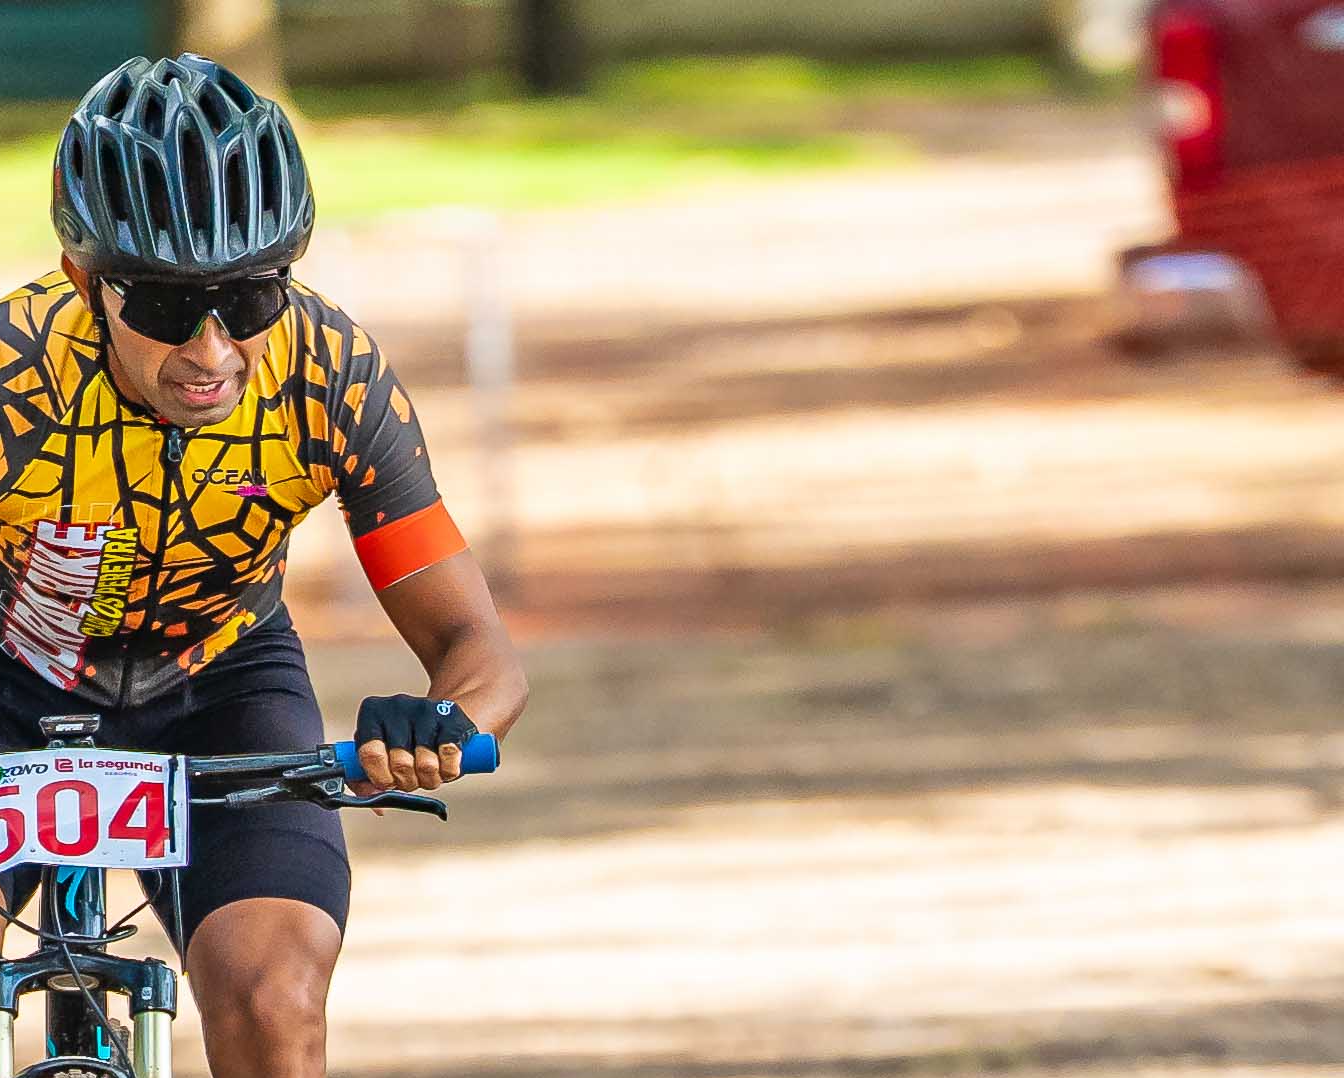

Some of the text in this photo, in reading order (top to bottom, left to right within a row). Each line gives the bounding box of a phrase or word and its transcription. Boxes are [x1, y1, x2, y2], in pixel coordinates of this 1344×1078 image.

[191, 468, 267, 485] OCEAN
[78, 758, 92, 769] la
[96, 759, 162, 773] segunda
